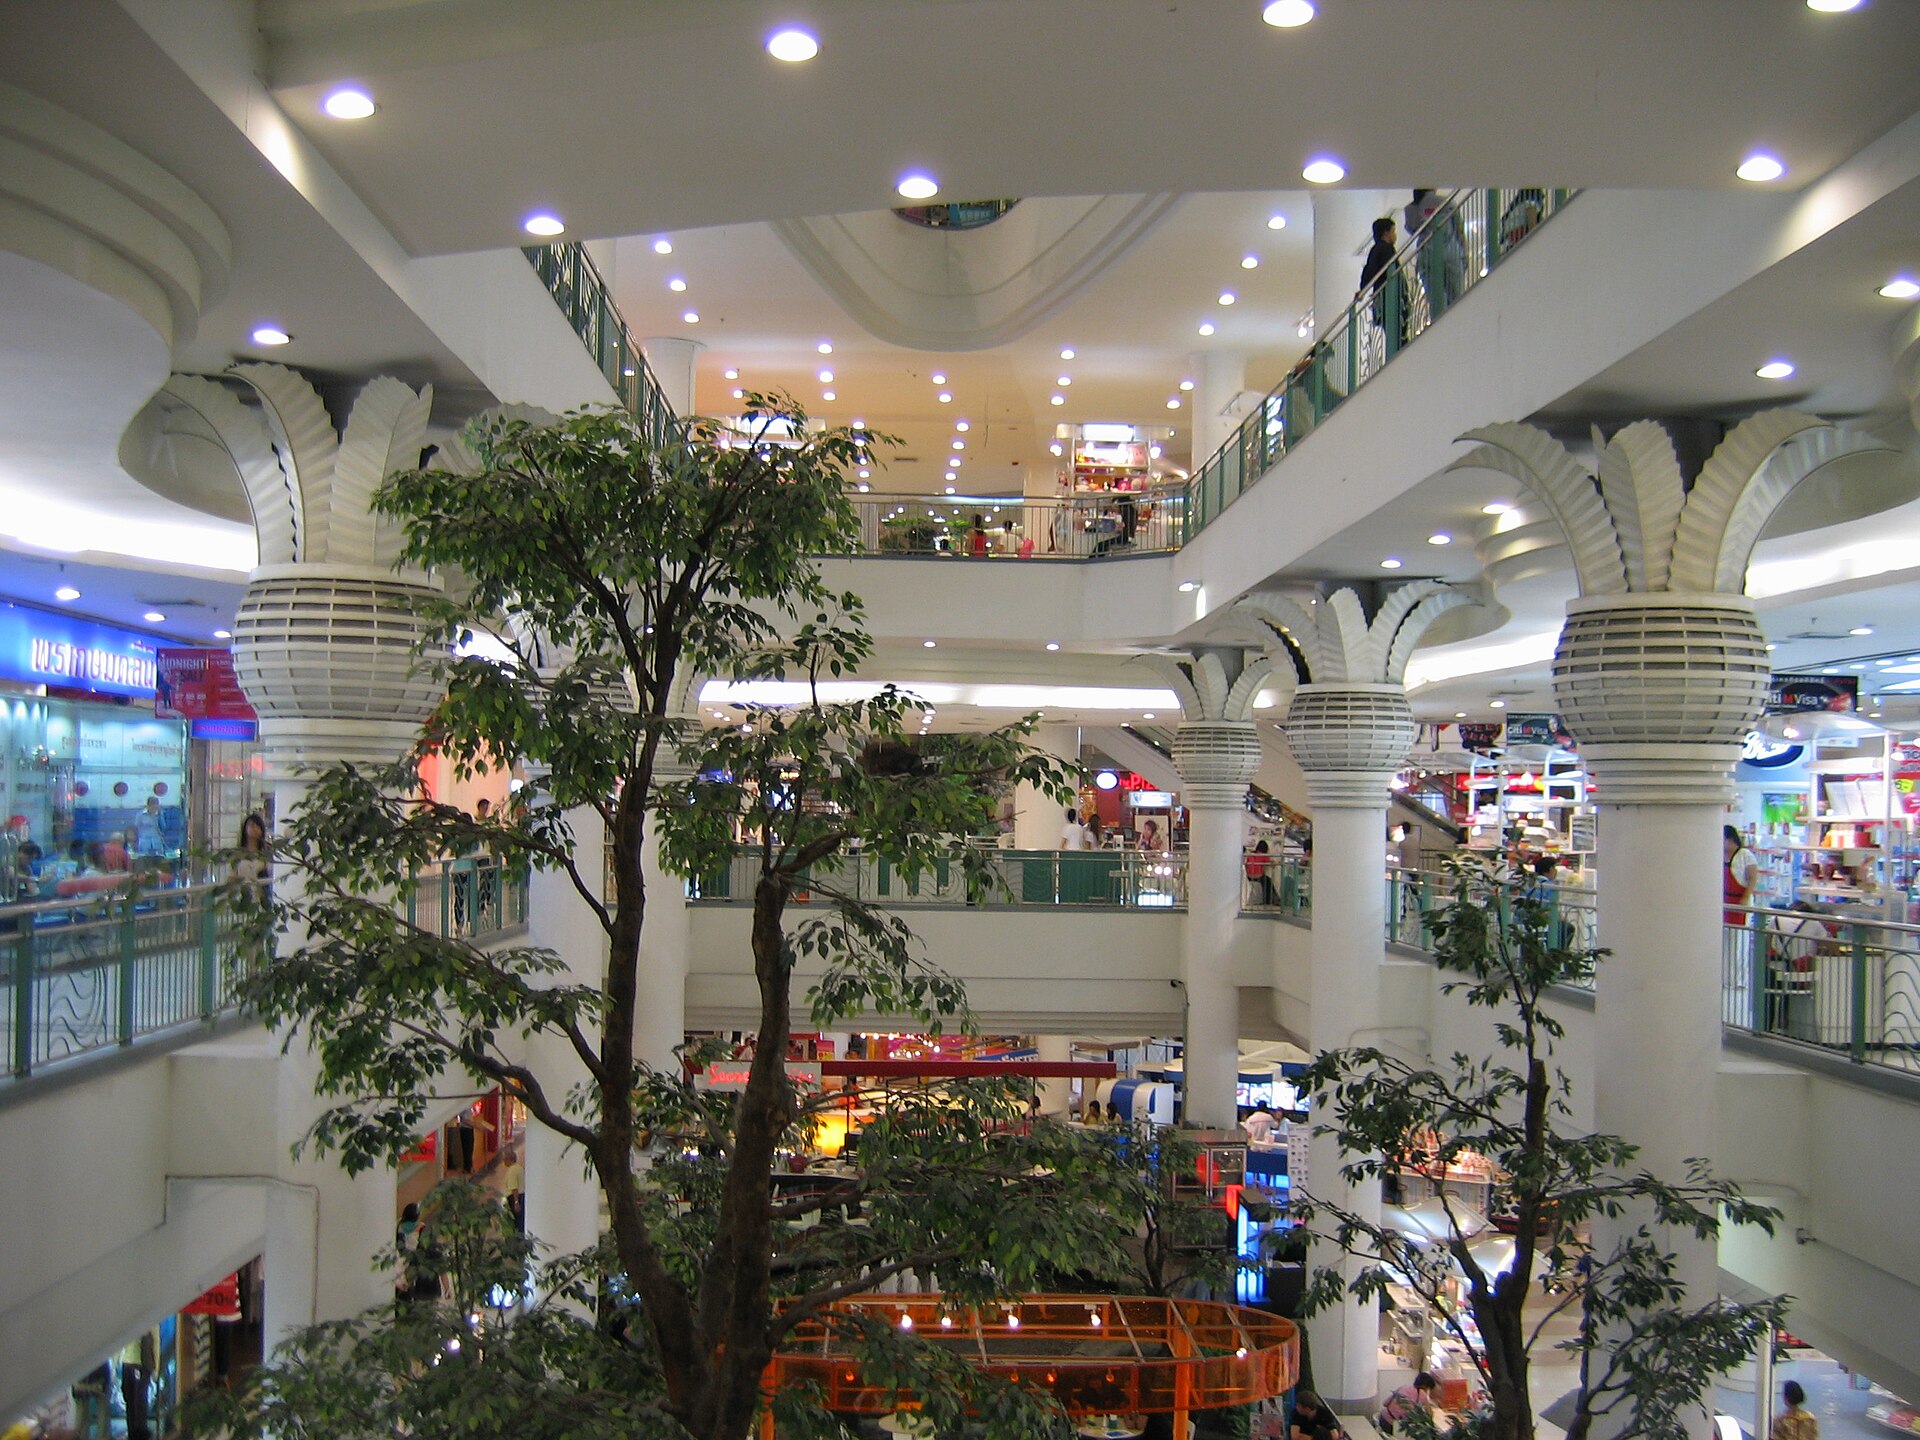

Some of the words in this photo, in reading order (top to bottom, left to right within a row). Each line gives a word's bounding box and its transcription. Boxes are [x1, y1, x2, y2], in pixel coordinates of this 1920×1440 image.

[158, 657, 205, 671] MIDNIGHT
[1766, 692, 1781, 704] iti
[1794, 693, 1818, 705] Visa
